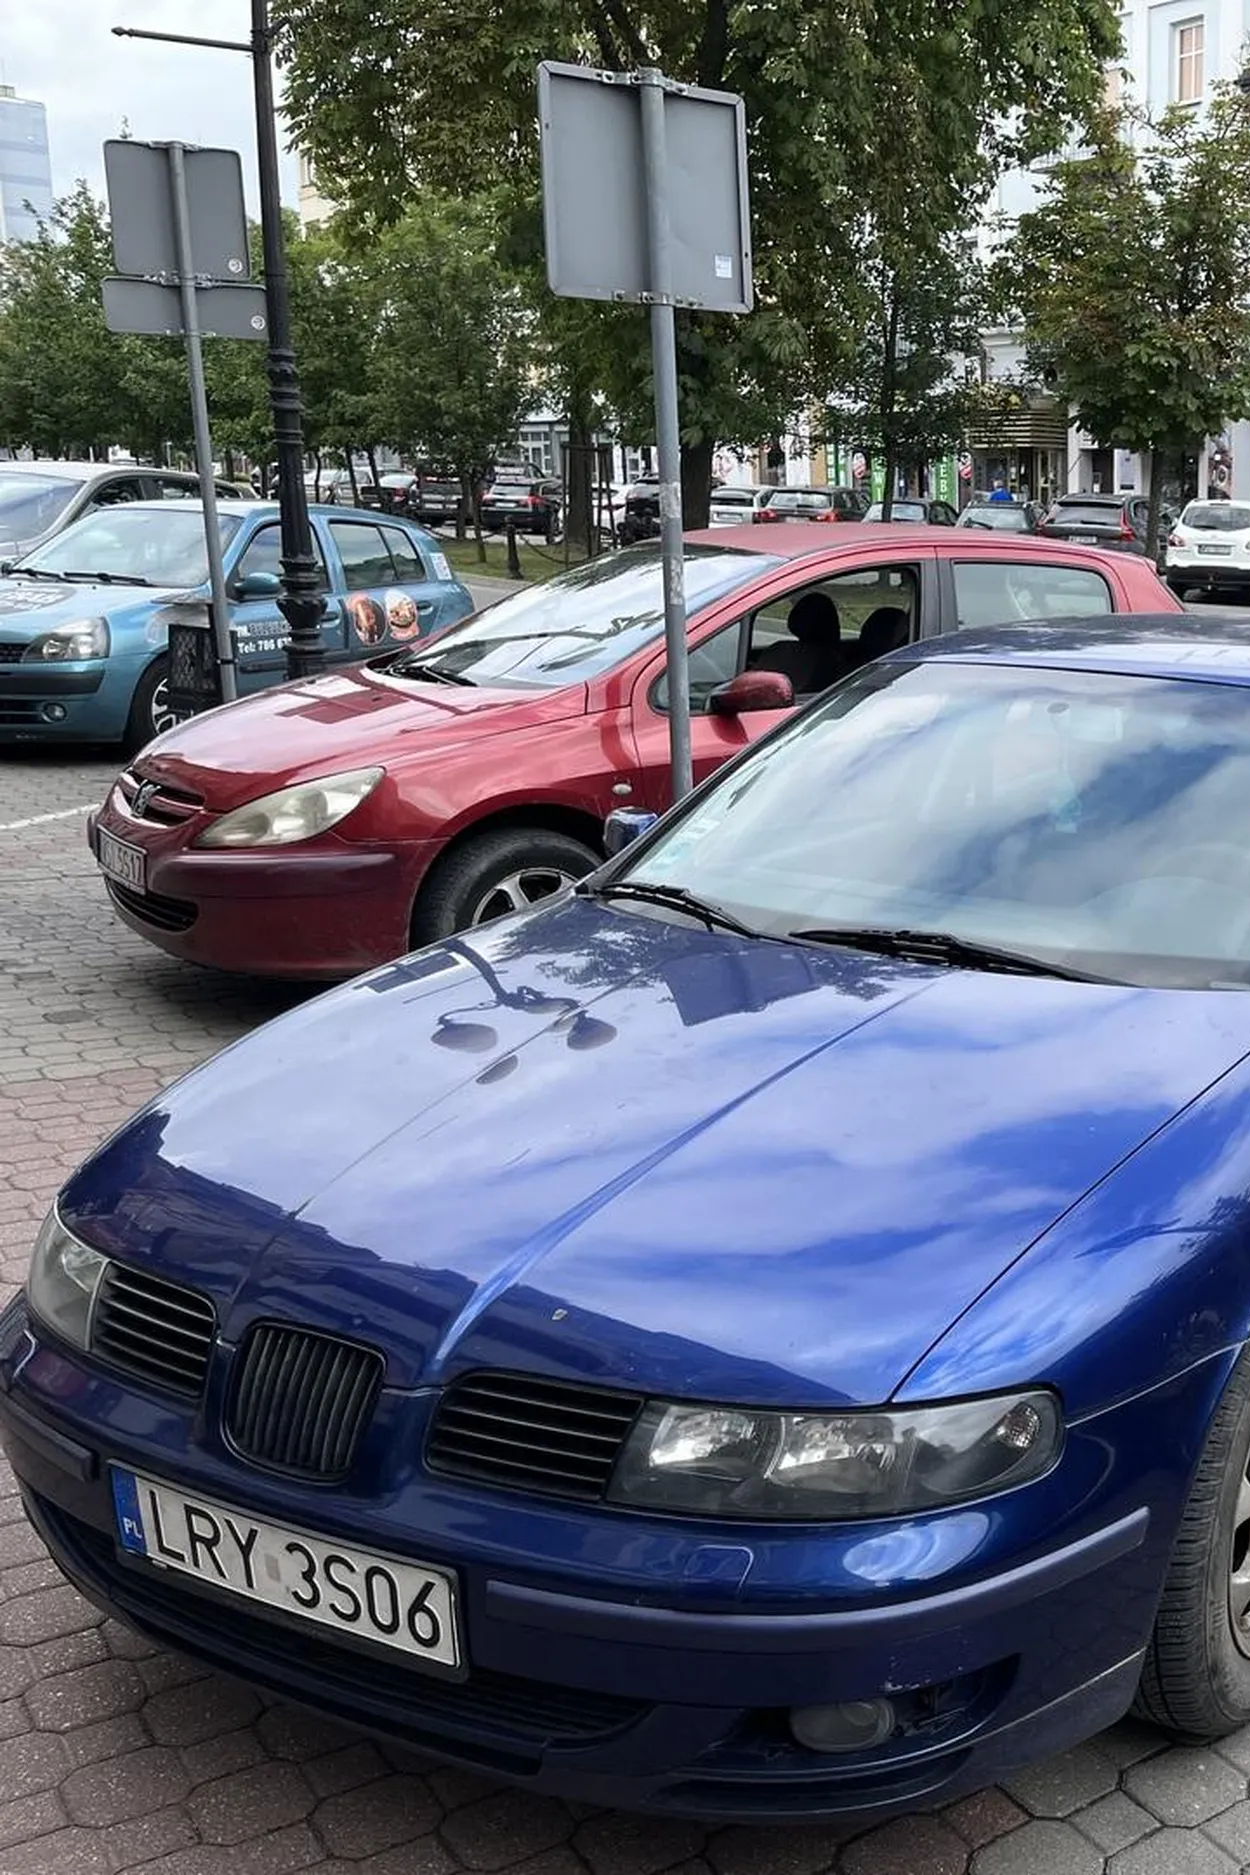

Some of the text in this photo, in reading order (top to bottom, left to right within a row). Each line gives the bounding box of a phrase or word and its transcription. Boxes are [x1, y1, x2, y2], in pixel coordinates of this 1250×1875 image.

[123, 1517, 142, 1540] PL
[149, 1490, 441, 1649] LRY 3S06
